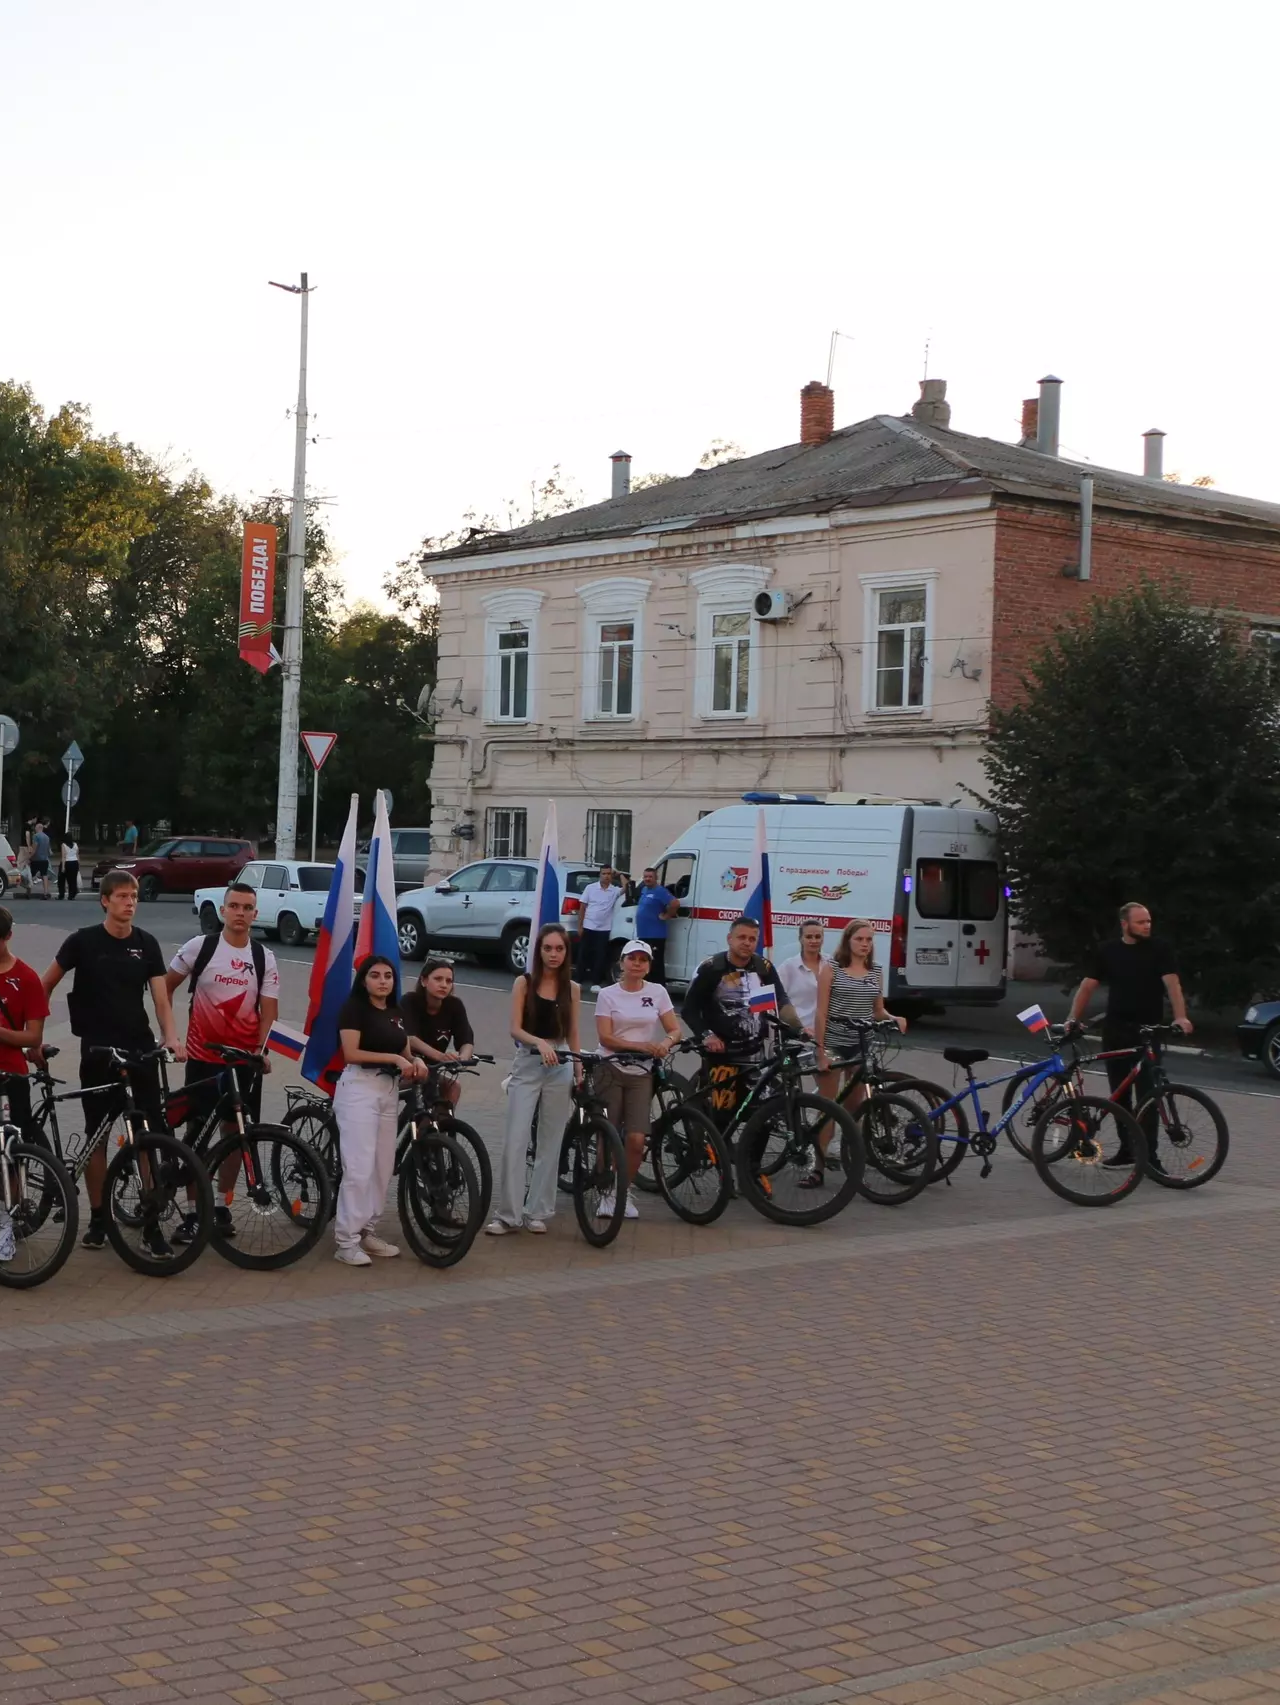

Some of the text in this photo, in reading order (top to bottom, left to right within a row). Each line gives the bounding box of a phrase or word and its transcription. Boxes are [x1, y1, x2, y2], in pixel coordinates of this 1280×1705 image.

[250, 538, 269, 614] ПОБЕДА!
[786, 867, 830, 875] праздником
[837, 868, 869, 877] Победы!
[718, 910, 743, 920] СКОРА
